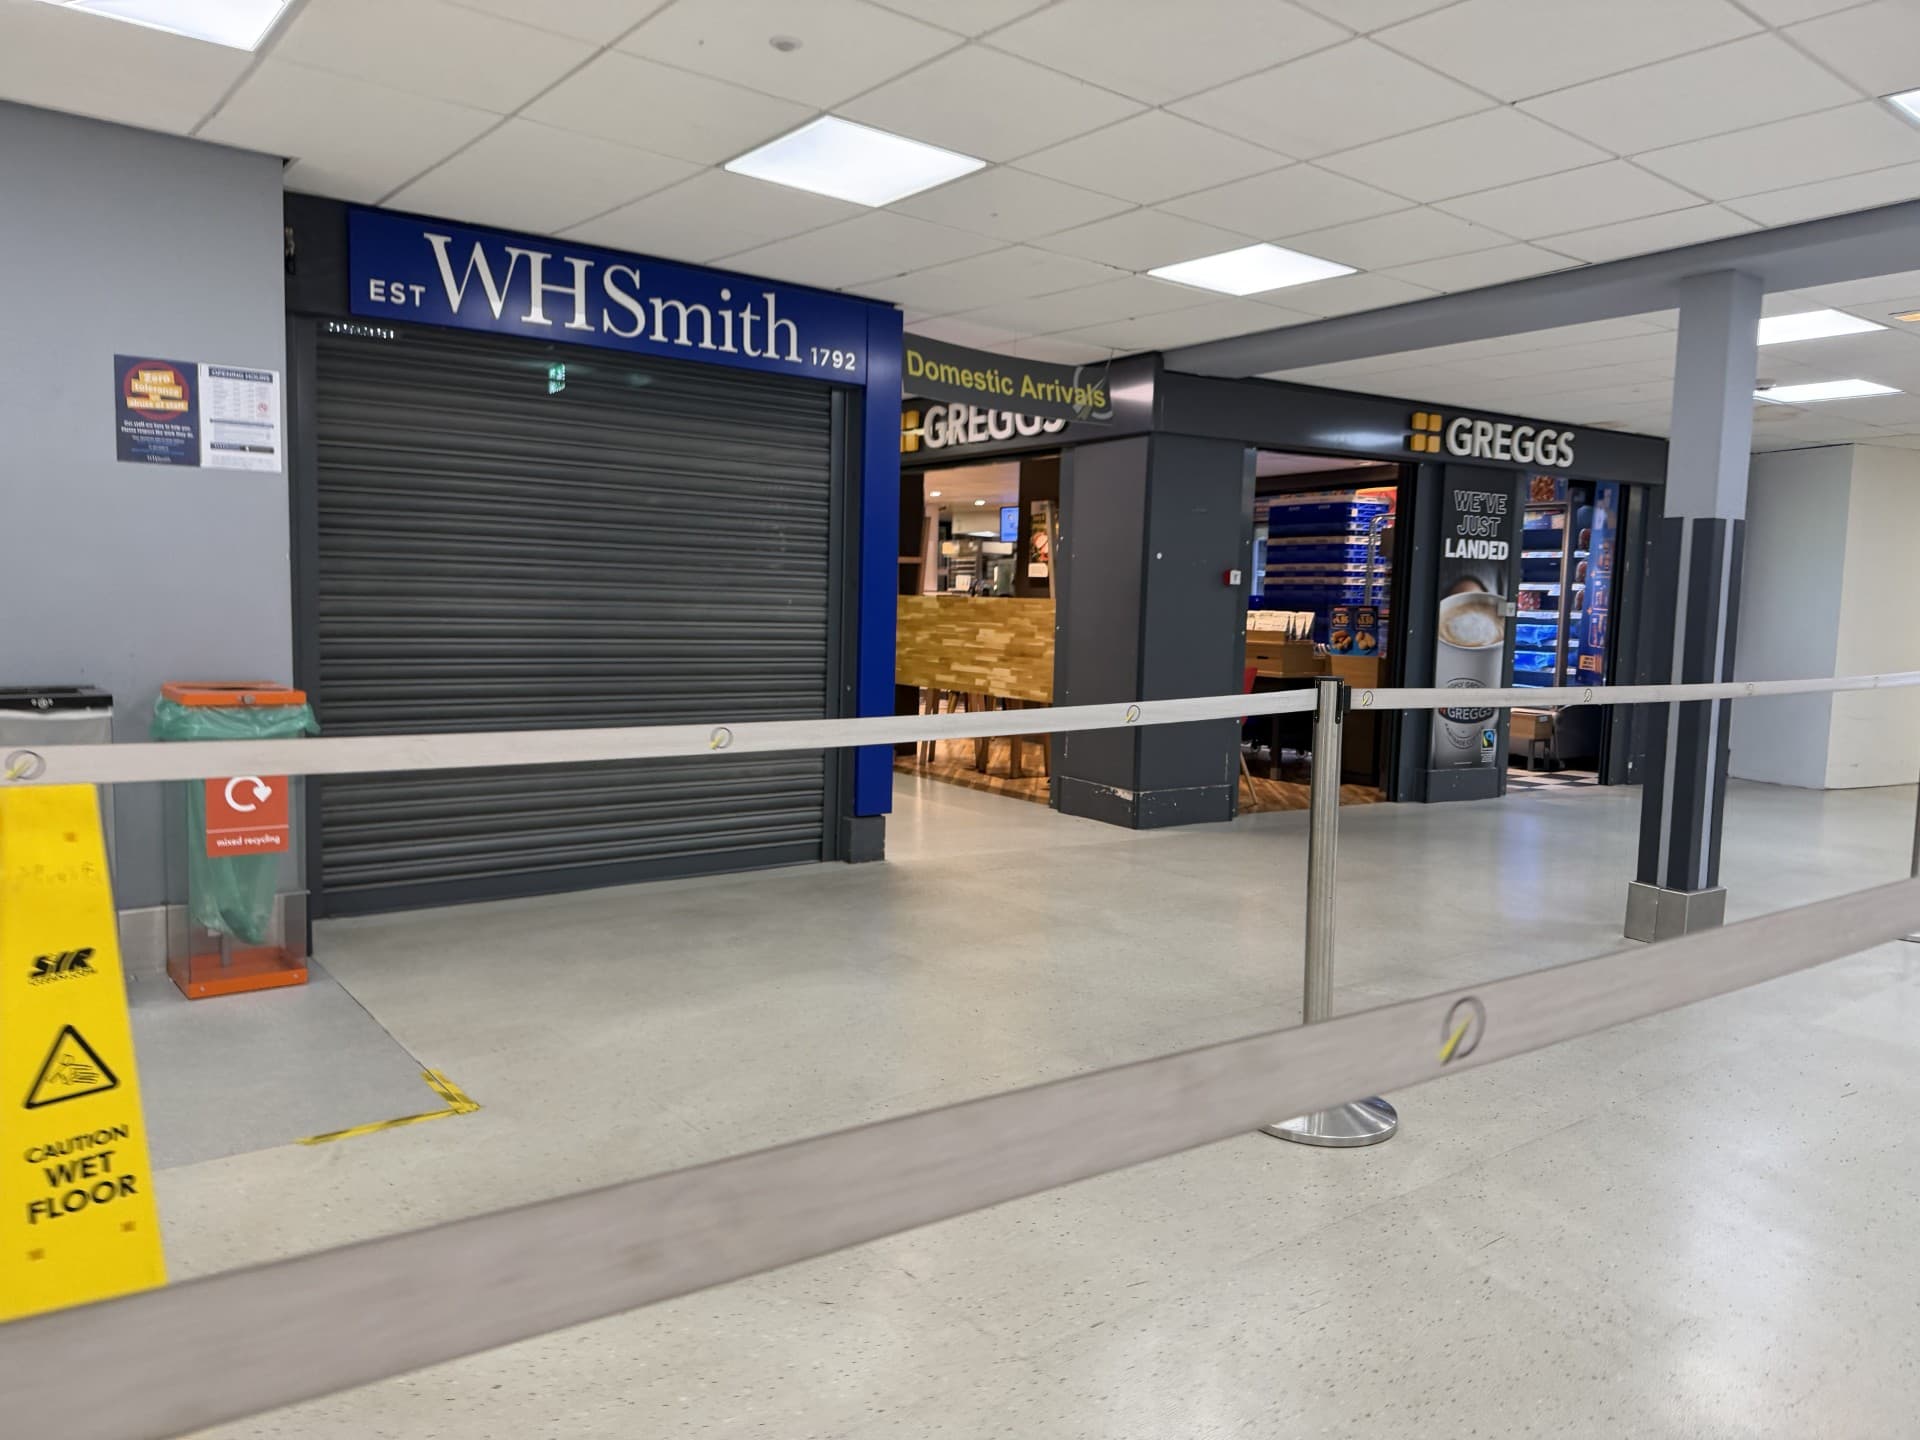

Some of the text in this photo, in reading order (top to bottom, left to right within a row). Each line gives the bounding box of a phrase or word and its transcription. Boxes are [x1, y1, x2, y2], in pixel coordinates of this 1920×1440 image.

[369, 279, 426, 307] EST
[423, 232, 802, 363] WHSmith
[811, 346, 857, 372] 1792
[906, 350, 1107, 409] Domestic Arrivals
[1446, 417, 1576, 467] GREGGS
[1456, 515, 1501, 537] JUST
[1444, 538, 1509, 561] LANDED
[216, 834, 281, 848] mixed recycling
[24, 1124, 129, 1164] CAUTION
[43, 1150, 115, 1188] WET
[27, 1174, 138, 1225] FLOOR
